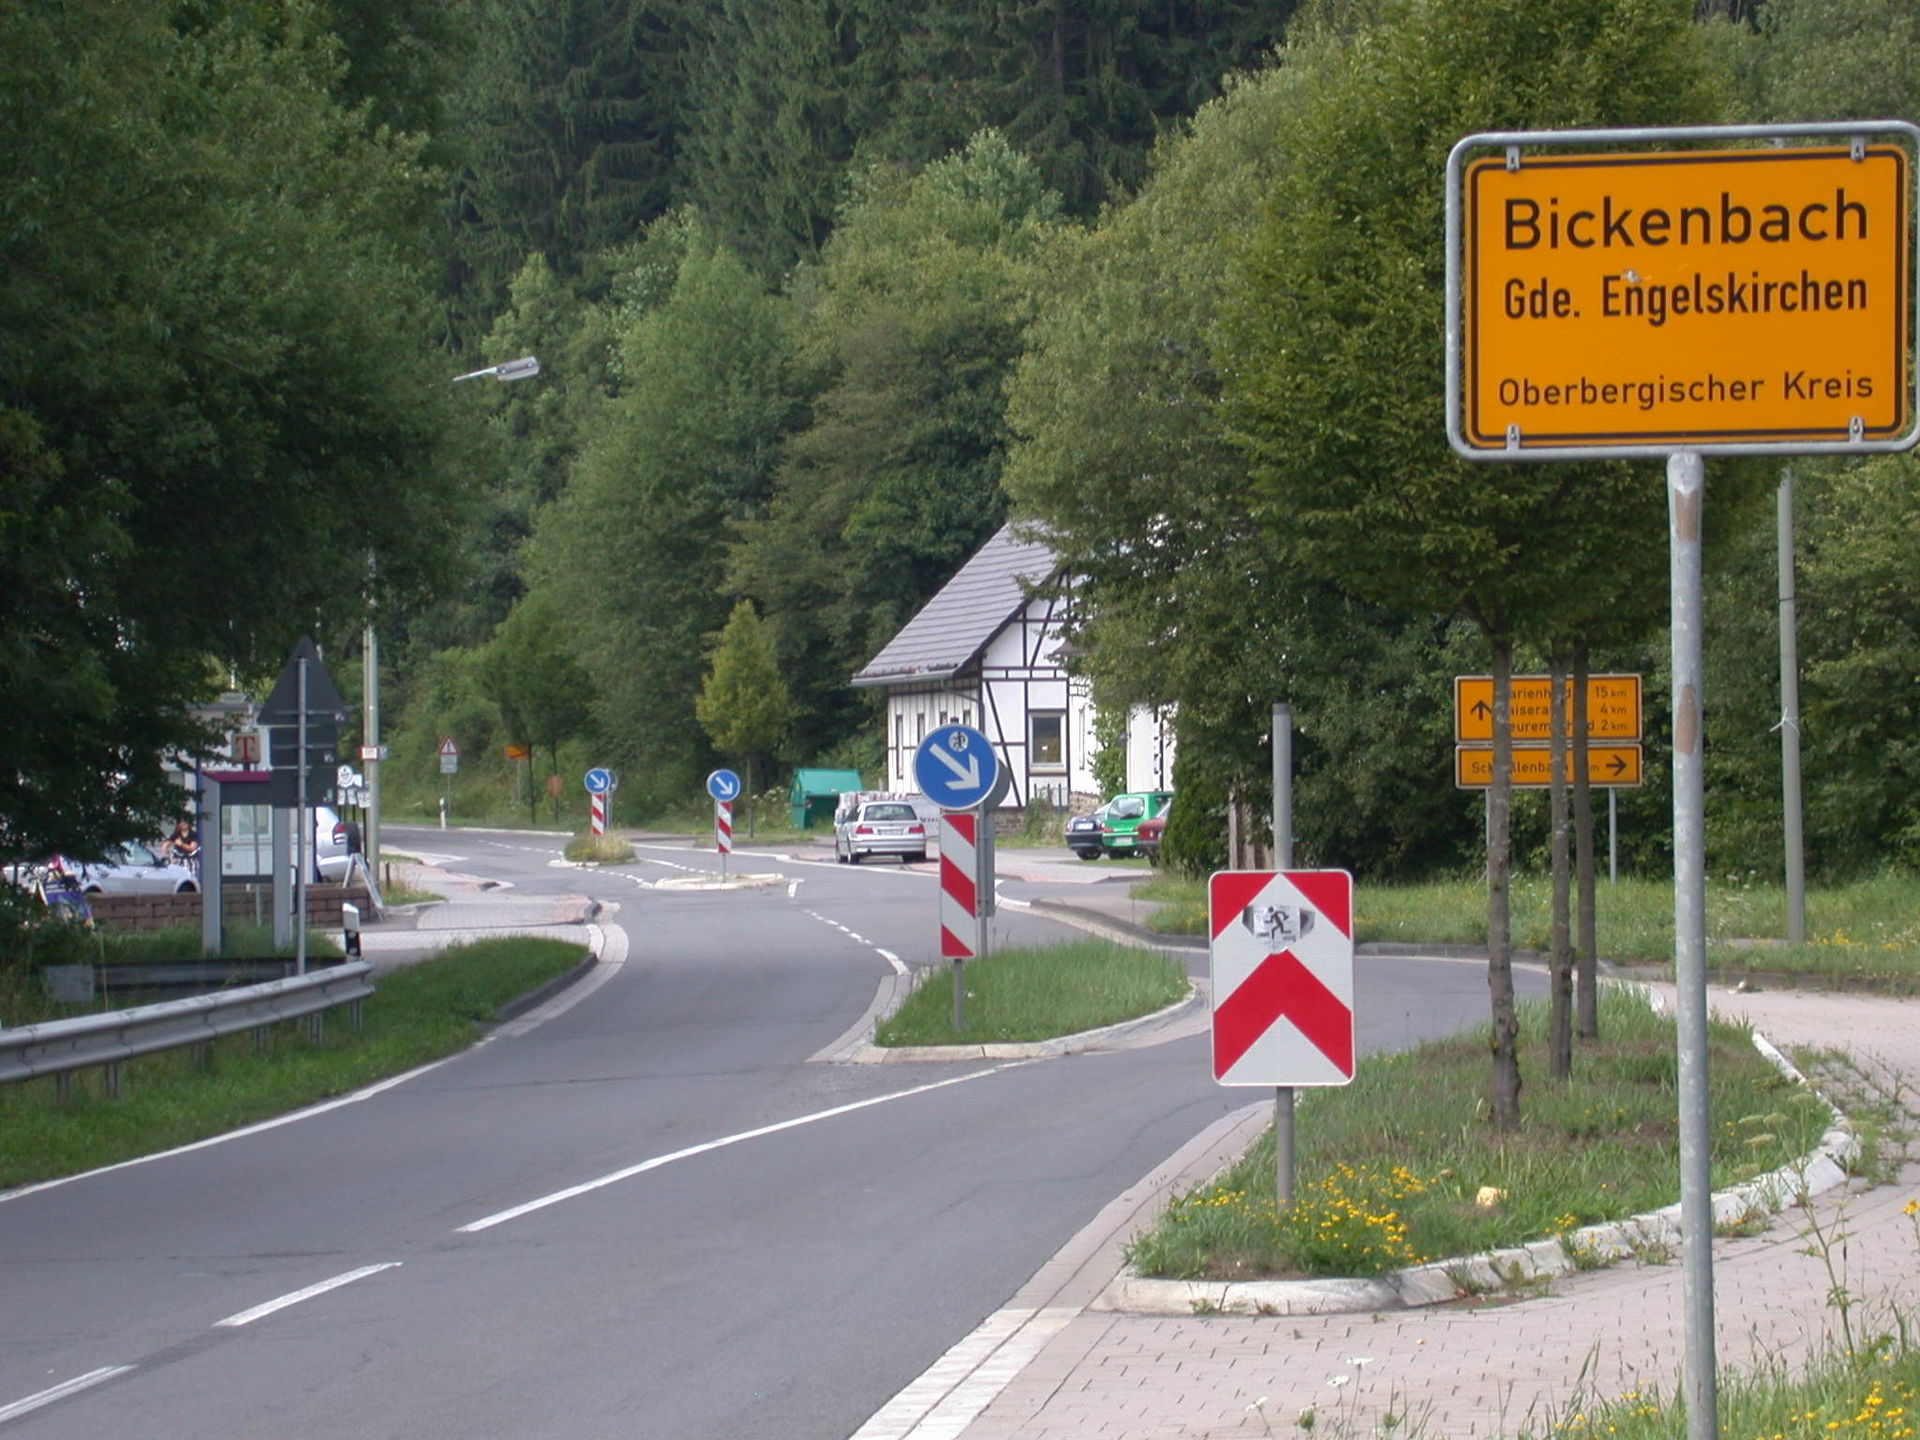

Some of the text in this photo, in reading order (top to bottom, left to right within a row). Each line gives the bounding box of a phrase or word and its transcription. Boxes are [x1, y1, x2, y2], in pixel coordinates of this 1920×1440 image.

[1504, 187, 1868, 250] Bickenbach
[1504, 269, 1867, 327] Gde. Engelskirchen
[1499, 370, 1873, 411] Oberbergischer Kreis
[1595, 685, 1608, 698] 15
[1611, 689, 1627, 697] km
[1600, 703, 1608, 714] 4
[1611, 705, 1627, 713] km
[1601, 719, 1609, 731] 2
[1611, 721, 1627, 730] km
[235, 735, 255, 761] T
